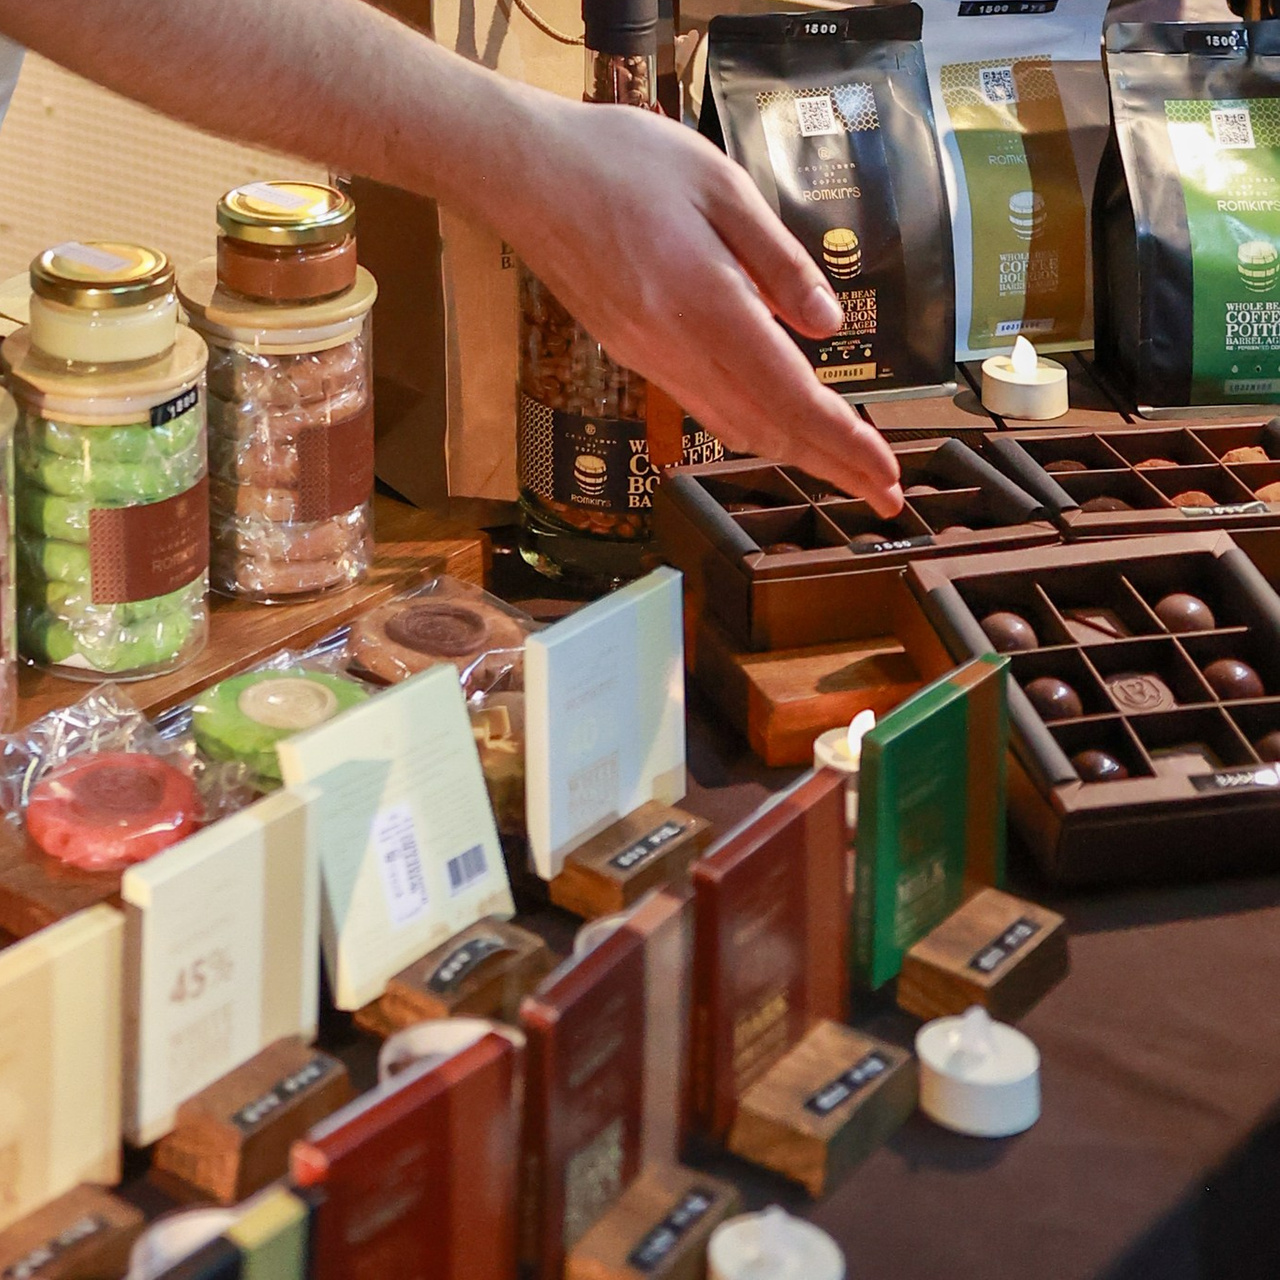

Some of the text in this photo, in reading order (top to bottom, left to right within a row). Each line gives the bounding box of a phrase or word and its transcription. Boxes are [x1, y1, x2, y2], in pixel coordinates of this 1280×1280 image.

[980, 4, 1009, 14] 1500
[851, 289, 876, 299] BEAN
[838, 297, 877, 311] FFEE
[1226, 302, 1263, 311] WHOLE
[843, 310, 877, 322] RBON
[852, 319, 877, 330] AGED
[1226, 336, 1263, 346] BARREL
